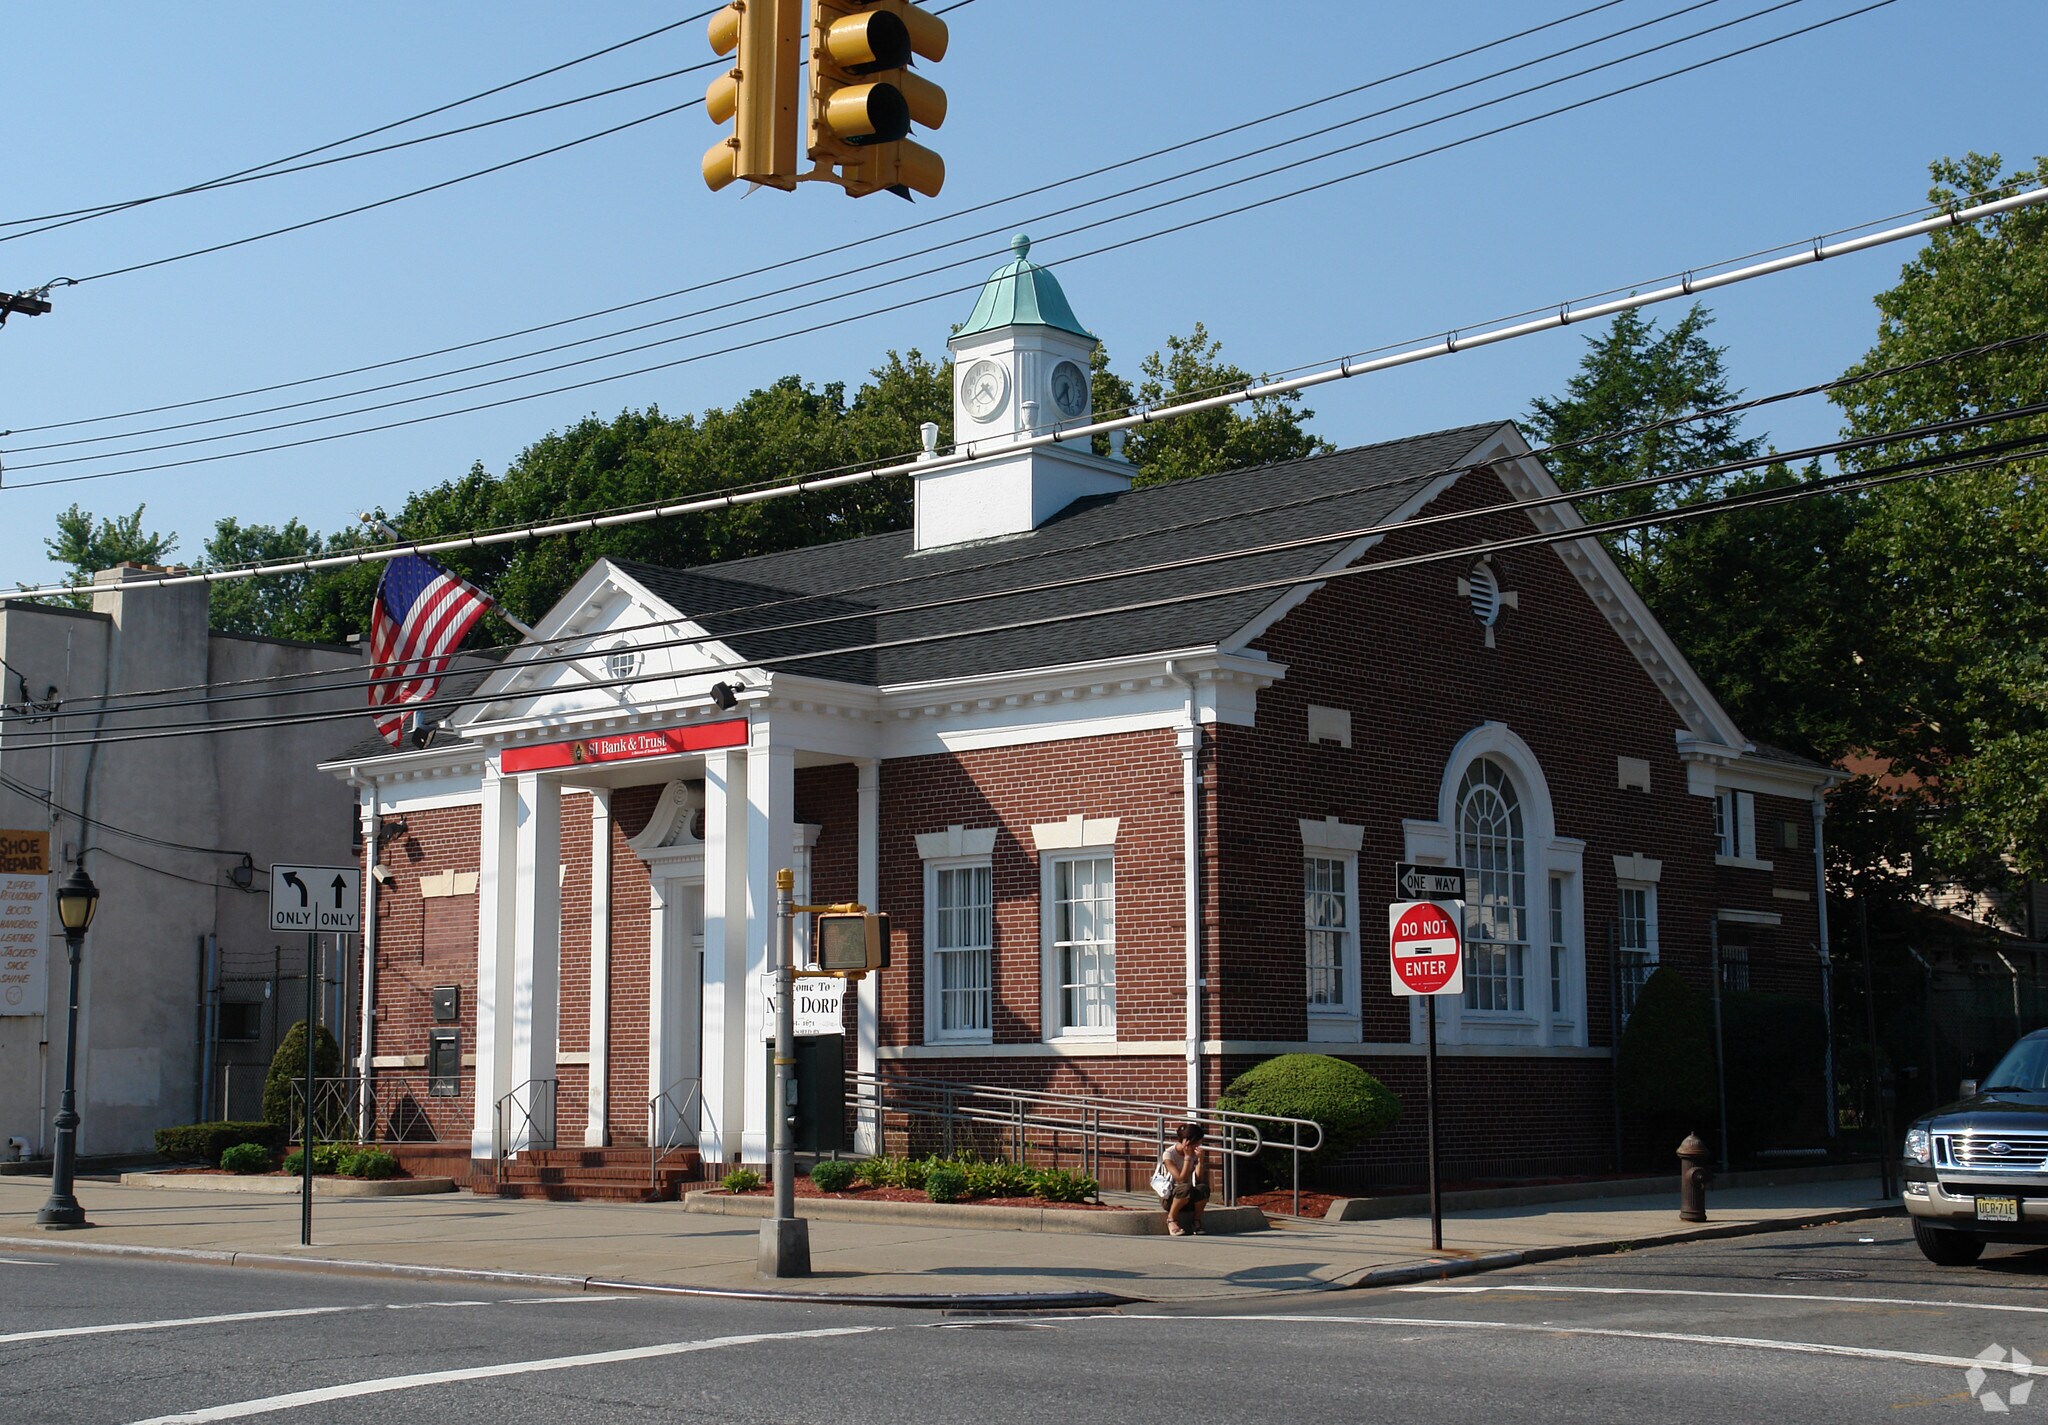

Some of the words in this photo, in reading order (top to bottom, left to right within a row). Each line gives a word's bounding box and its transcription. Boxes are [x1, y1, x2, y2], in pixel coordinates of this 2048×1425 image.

[588, 742, 599, 756] SI
[601, 739, 627, 754] Bank
[628, 737, 637, 750] &
[638, 733, 667, 749] Trust
[0, 837, 40, 855] SHOE
[0, 855, 42, 872] REPAIR
[1407, 876, 1426, 889] ONE
[1434, 877, 1456, 891] WAY
[5, 905, 32, 915] BOOTS
[276, 912, 311, 924] ONLY
[321, 913, 355, 926] ONLY
[1401, 922, 1418, 936] DO
[1423, 919, 1447, 935] NOT
[1, 933, 35, 943] LEATHER
[1, 945, 38, 957] JACKETS
[4, 961, 30, 970] SHOE
[1405, 960, 1446, 977] ENTER
[0, 974, 31, 983] SHINE
[818, 982, 831, 991] To
[801, 996, 838, 1014] DORP
